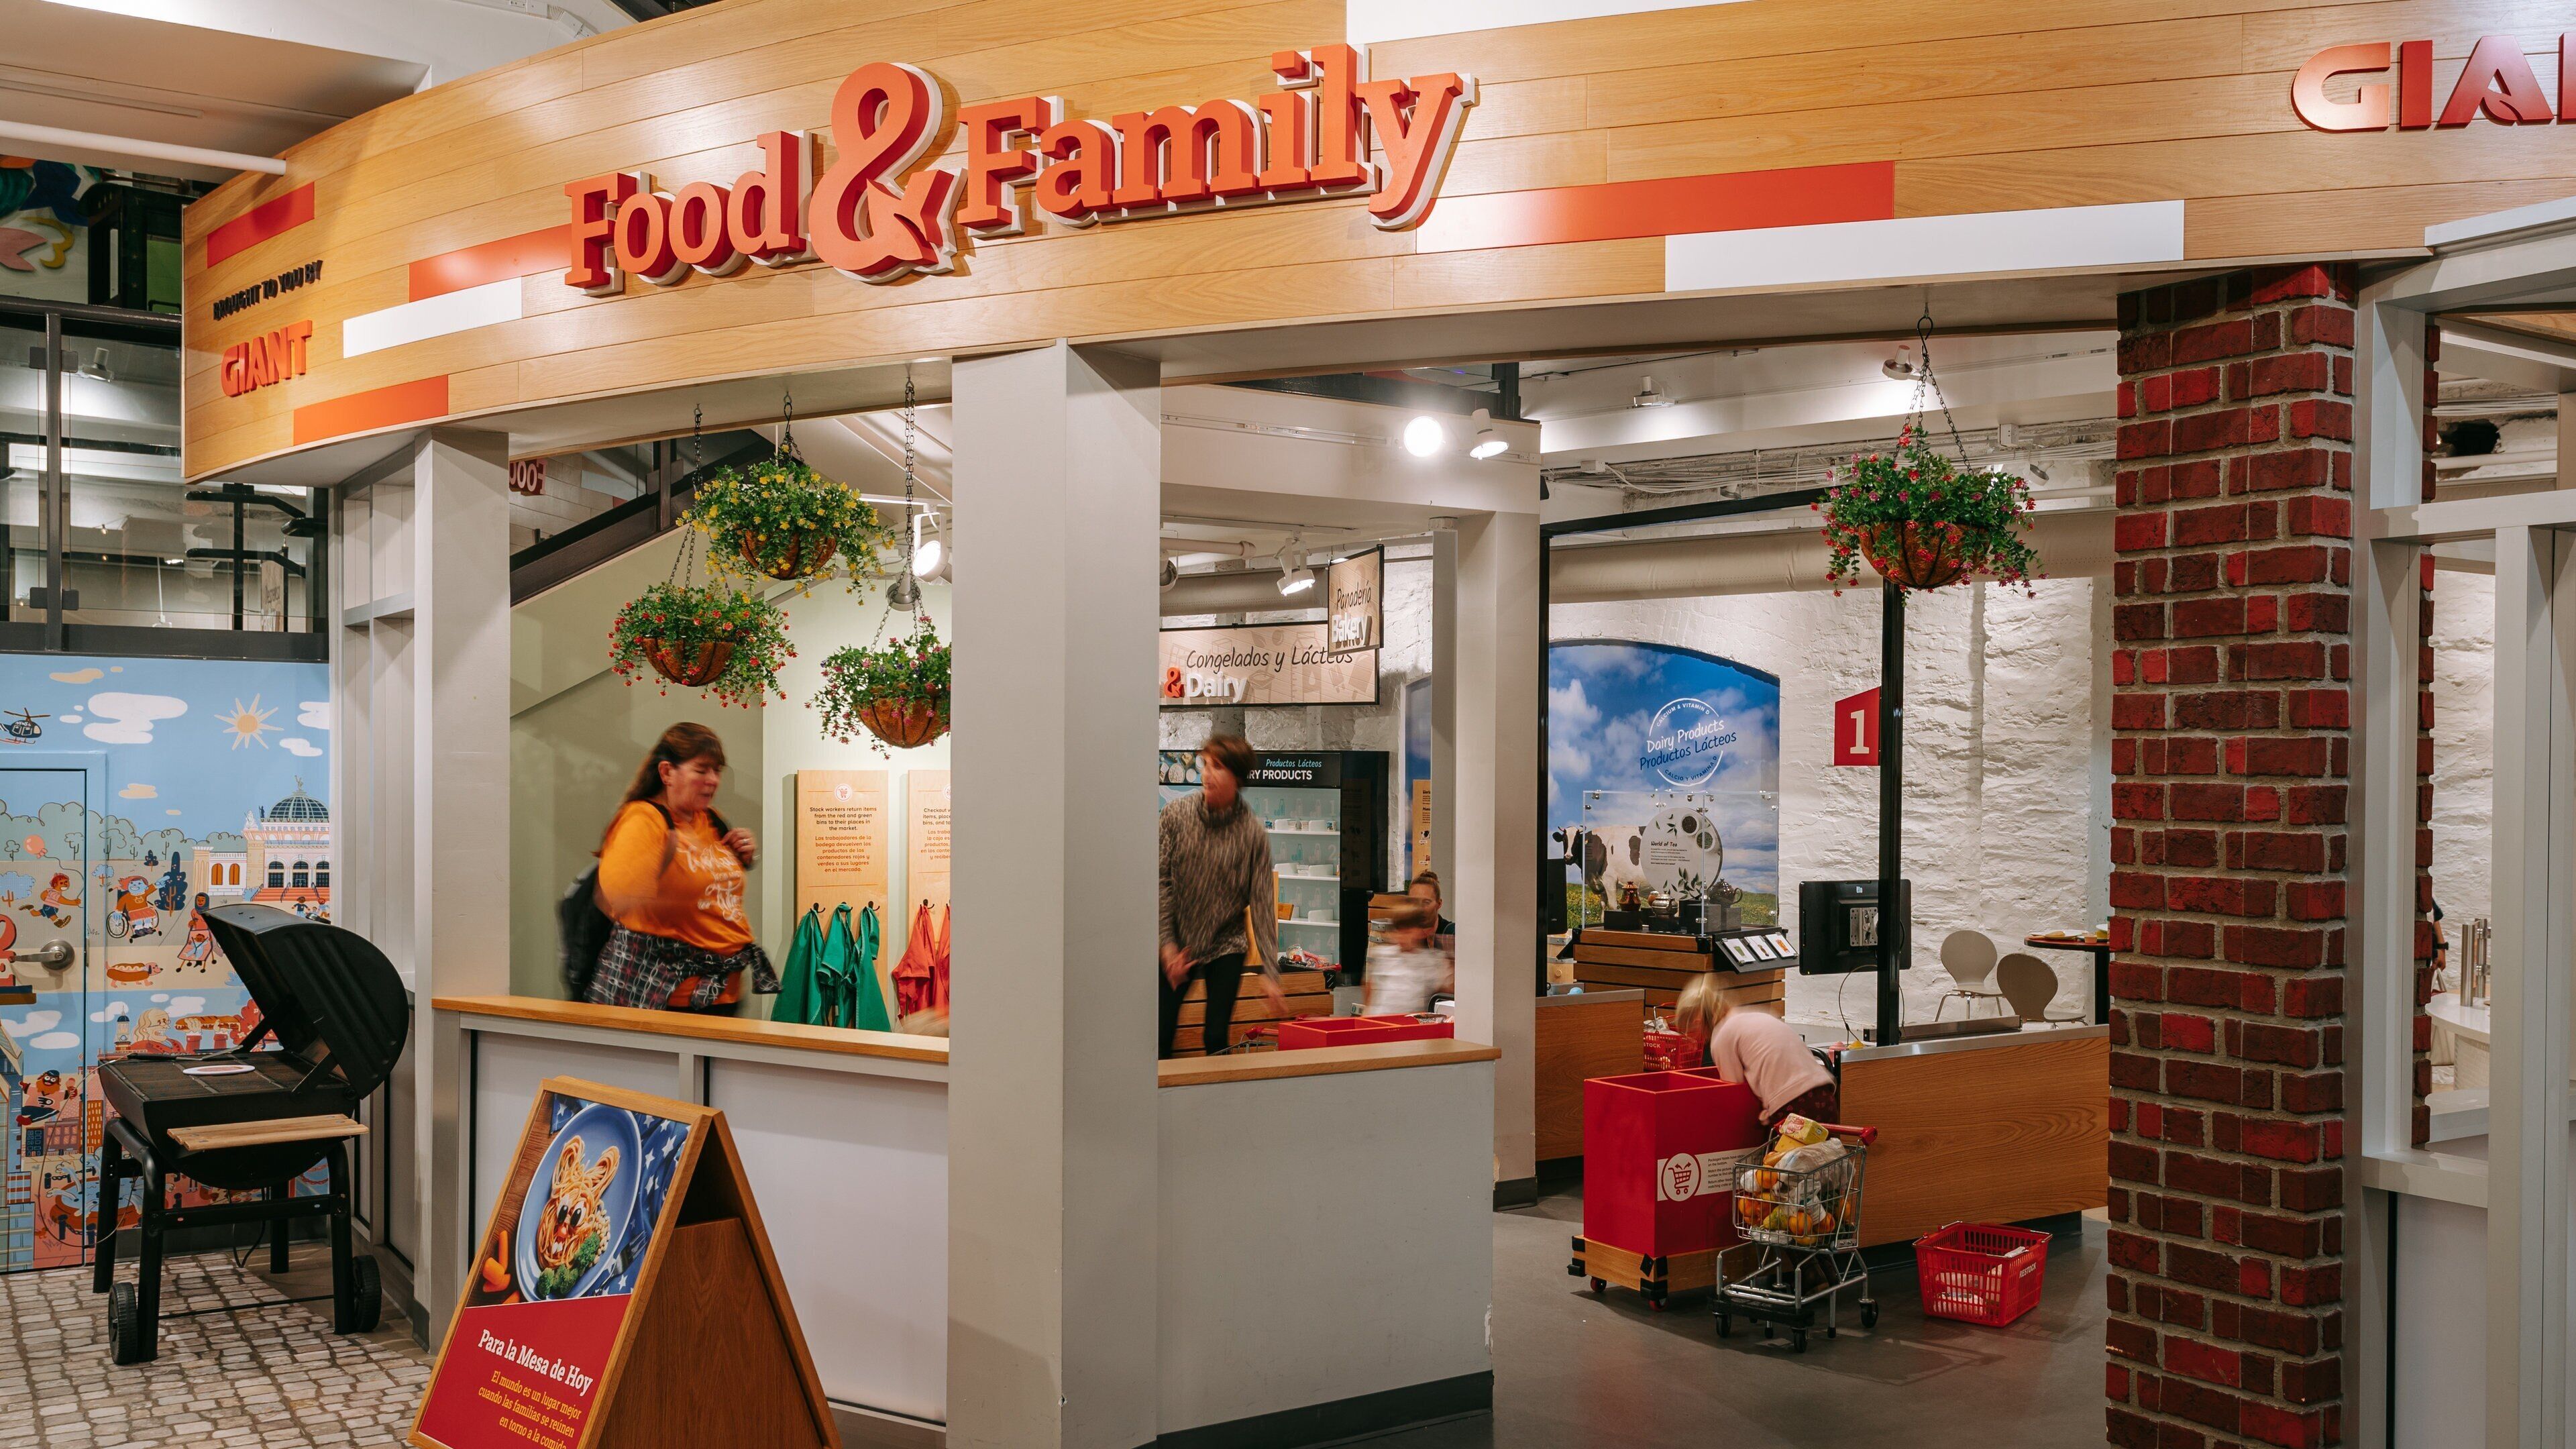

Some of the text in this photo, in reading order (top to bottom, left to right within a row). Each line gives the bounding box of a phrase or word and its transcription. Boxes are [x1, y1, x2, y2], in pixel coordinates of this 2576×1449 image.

[564, 43, 1473, 294] Food & Family
[213, 260, 323, 321] BROUGHT TO YOU BY
[221, 319, 313, 398] GIANT
[1336, 580, 1372, 610] Panadería
[1332, 612, 1370, 647] Bakery
[1186, 645, 1269, 674] Congelados
[1275, 651, 1285, 673] y
[1164, 667, 1248, 703] & Dairy
[1656, 706, 1676, 727] CALCIUM
[1682, 702, 1705, 712] VITAMIN
[1849, 709, 1870, 754] 1
[1640, 732, 1737, 771] Productos Lácteos
[1647, 719, 1725, 753] Dairy Products
[1263, 769, 1313, 780] PRODUCTS
[1265, 758, 1323, 768] Productos Lácteos
[1664, 769, 1684, 781] CALCIO
[1691, 761, 1715, 781] VITAMINA
[2019, 1262, 2037, 1279] RESTOCK
[478, 1329, 594, 1397] Para la Mesa de Hoy
[478, 1386, 575, 1438] cuando las familias se reúnen
[491, 1370, 582, 1420] El mundo es un lugar mejor
[499, 1416, 509, 1429] en
[508, 1419, 527, 1437] torno
[527, 1430, 533, 1440] a
[532, 1428, 541, 1443] la
